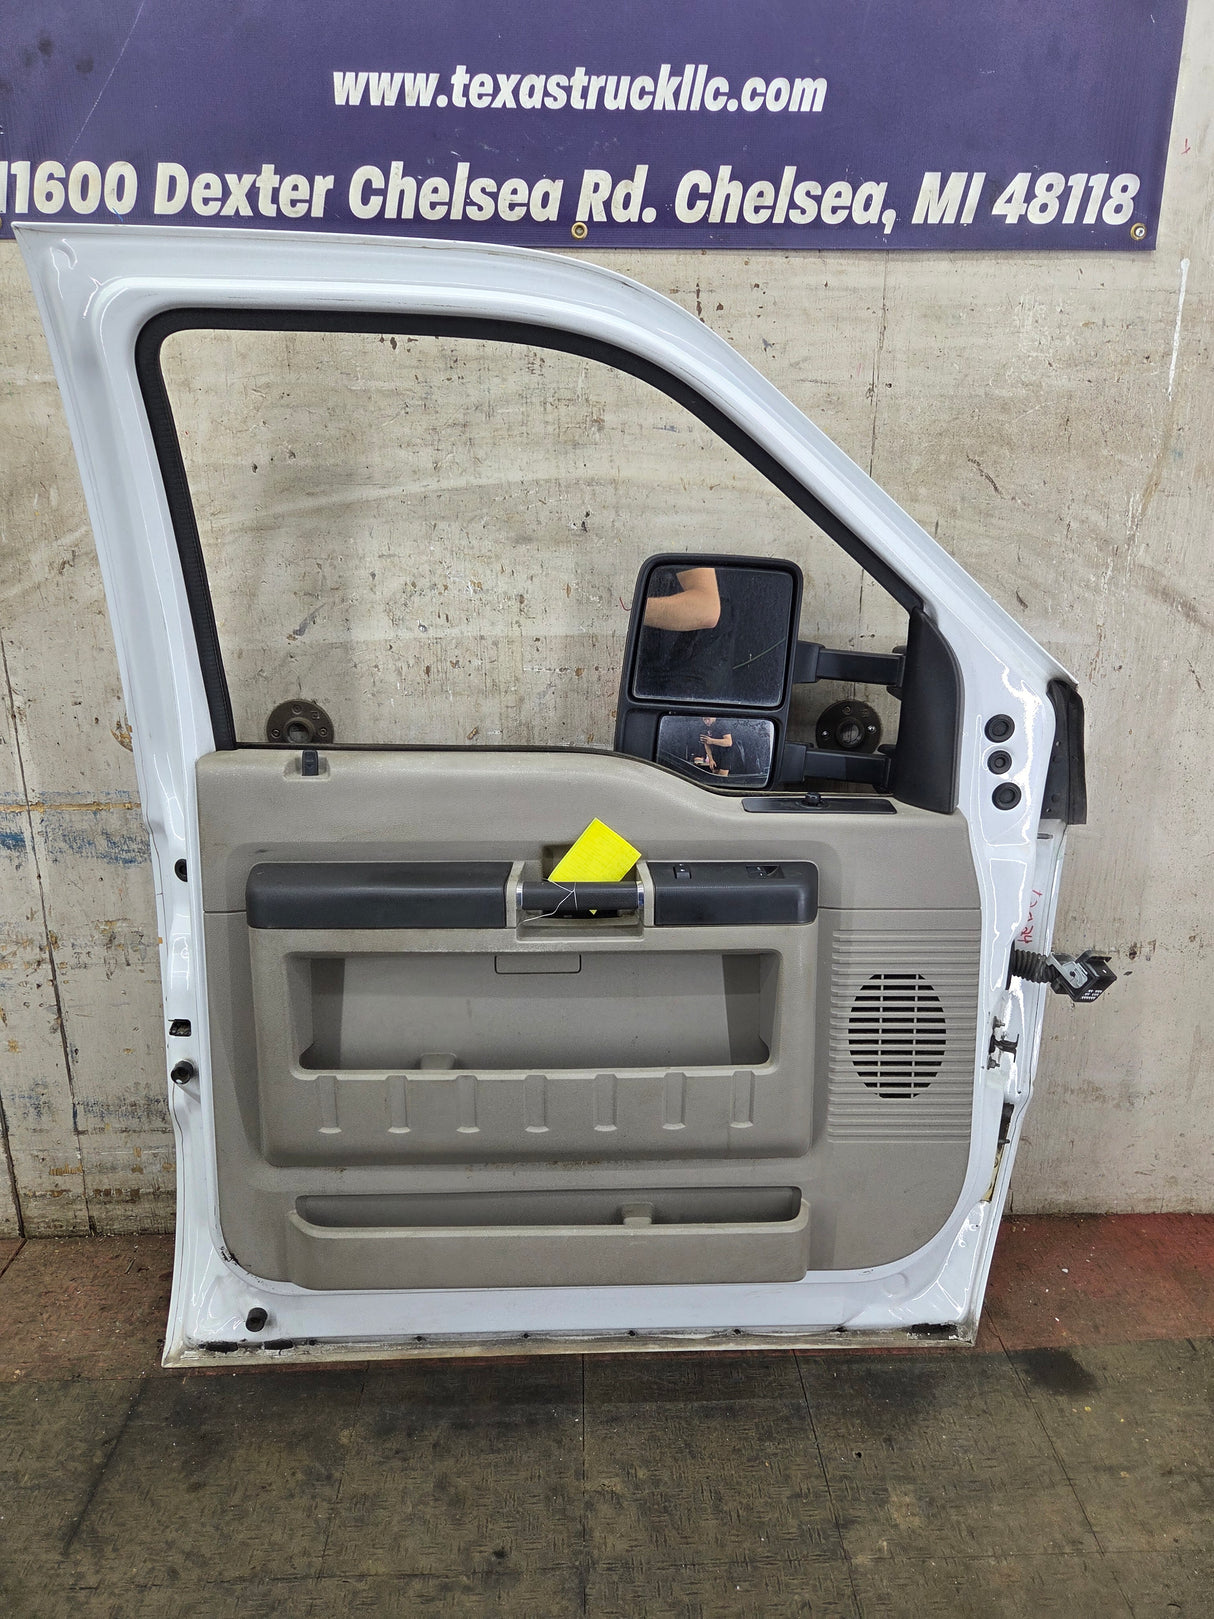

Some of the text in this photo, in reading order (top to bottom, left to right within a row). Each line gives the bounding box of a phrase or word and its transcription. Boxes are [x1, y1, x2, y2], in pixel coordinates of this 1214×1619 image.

[333, 64, 828, 113] www.texastruckllc.com
[154, 162, 334, 218] Dexter
[349, 161, 563, 222] Chelsea
[576, 164, 657, 223] Rd.
[674, 165, 897, 235] Chelsea,
[911, 171, 987, 224] MI
[991, 172, 1141, 226] 48118
